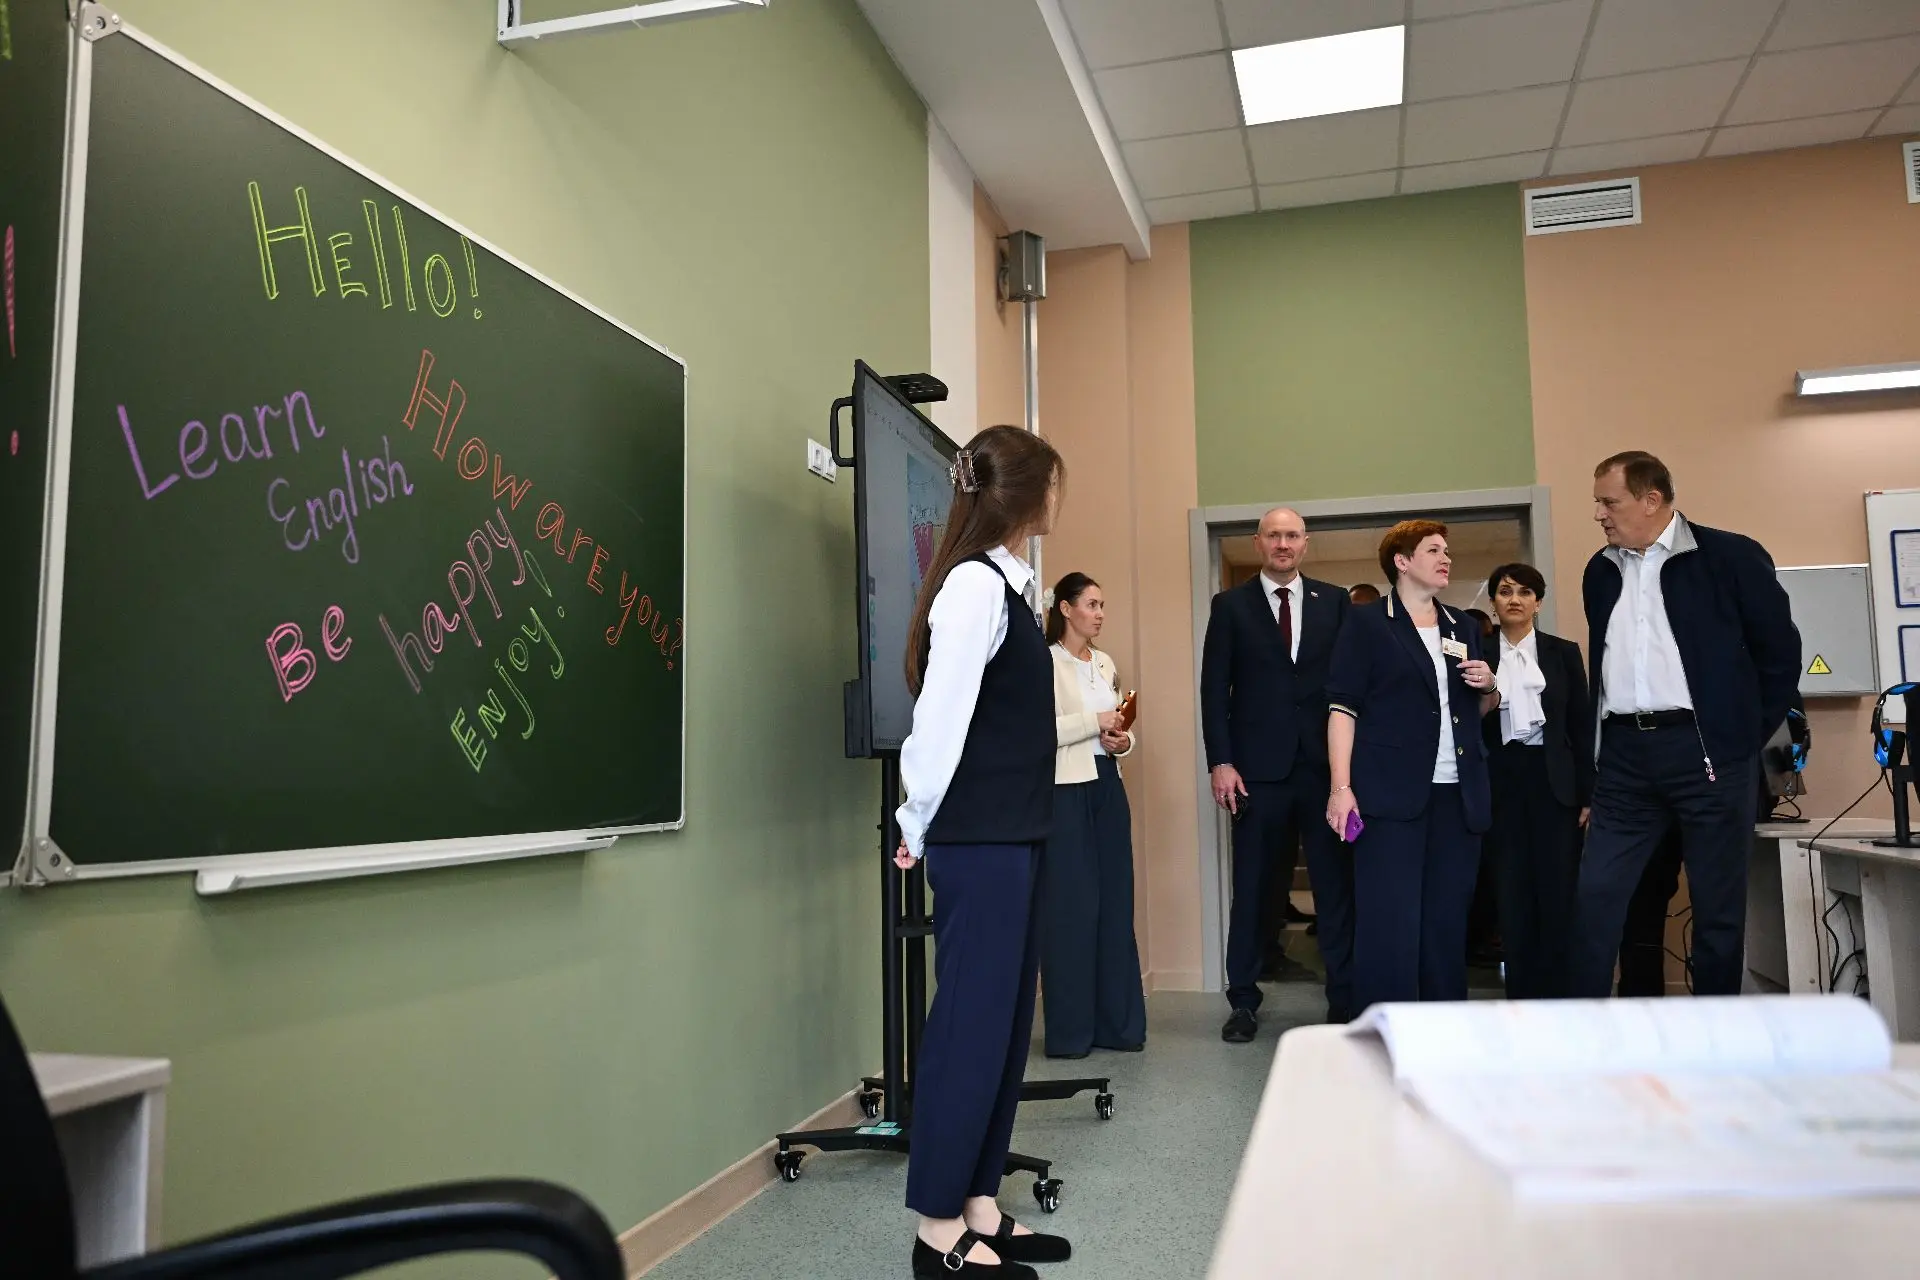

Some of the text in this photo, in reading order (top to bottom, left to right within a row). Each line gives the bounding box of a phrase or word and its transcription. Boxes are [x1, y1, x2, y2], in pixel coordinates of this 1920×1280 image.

[116, 389, 326, 500] Learn
[266, 435, 414, 564] English
[402, 349, 532, 510] How
[605, 570, 684, 671] you?
[265, 507, 526, 702] Be happy
